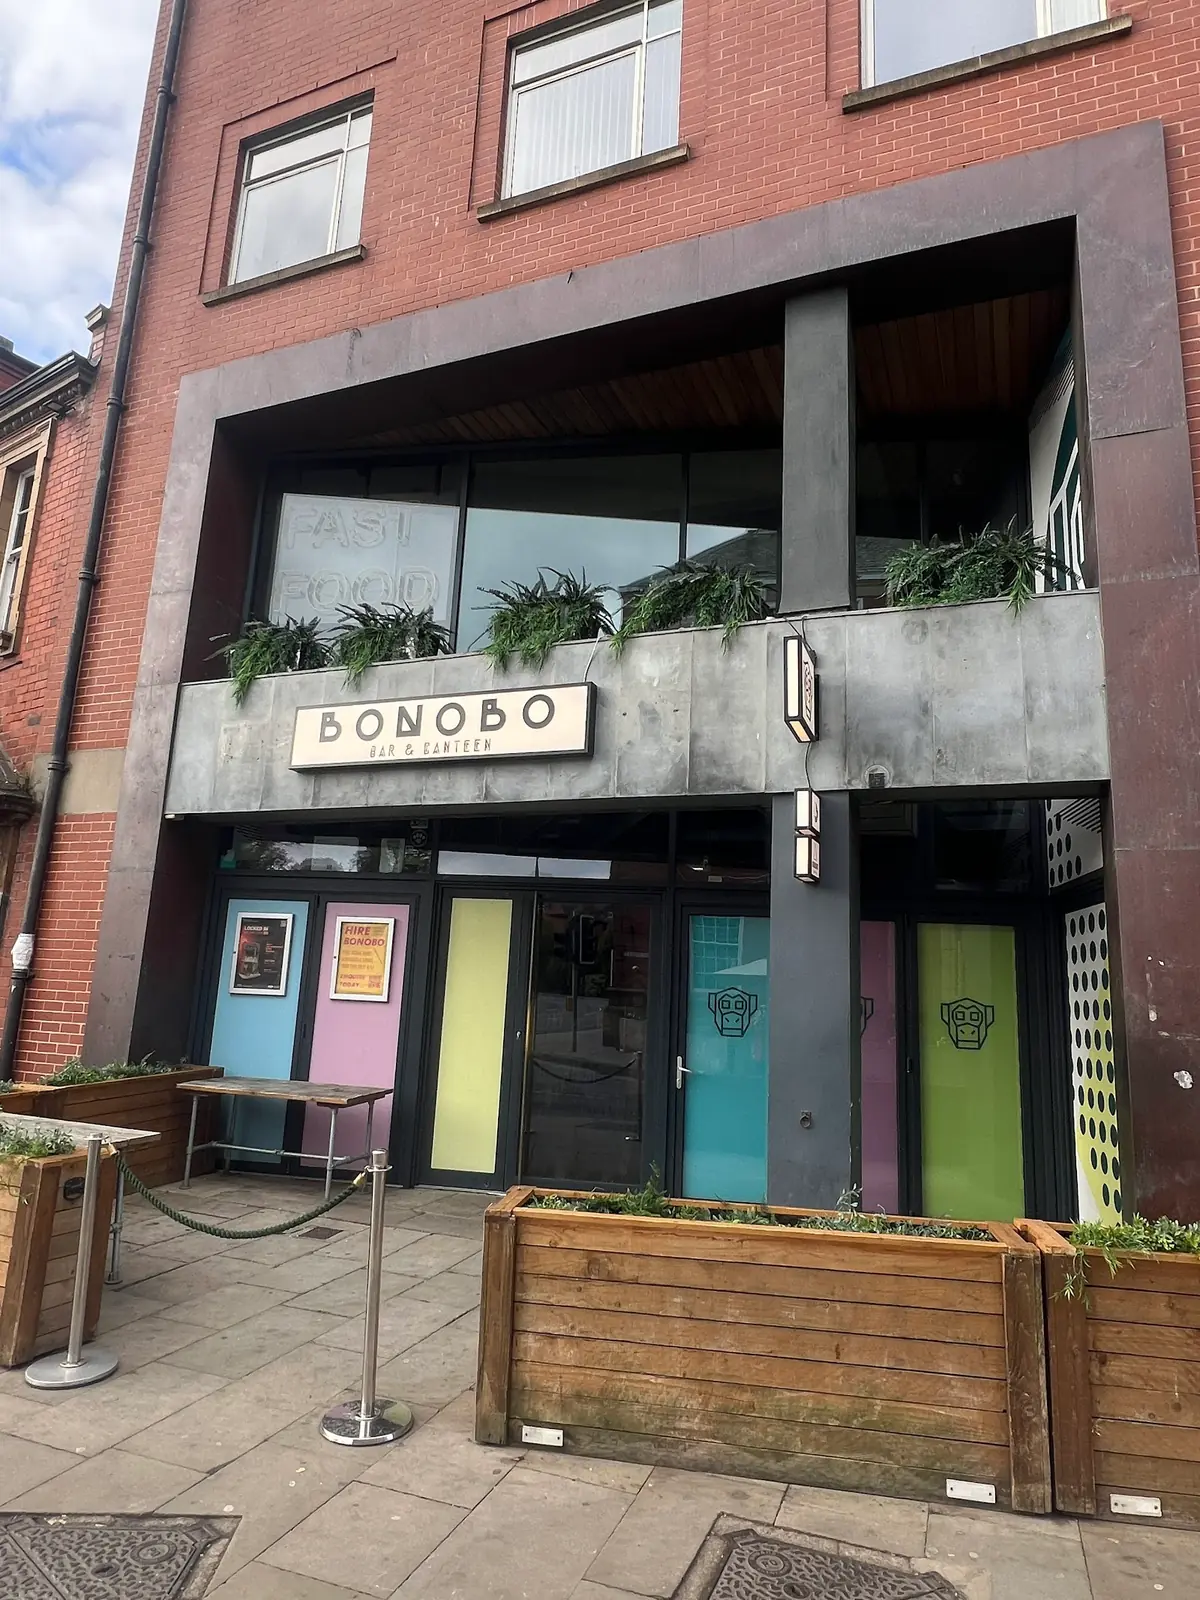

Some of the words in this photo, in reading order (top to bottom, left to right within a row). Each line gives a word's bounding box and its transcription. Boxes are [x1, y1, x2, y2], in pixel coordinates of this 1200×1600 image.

[287, 503, 416, 549] FAST
[274, 566, 440, 618] FOOD
[318, 693, 556, 743] BONOBO
[369, 744, 396, 758] BAR
[405, 743, 414, 756] &
[423, 738, 492, 755] CANTEEN
[344, 926, 371, 936] HIRE
[344, 938, 385, 946] BONOBO
